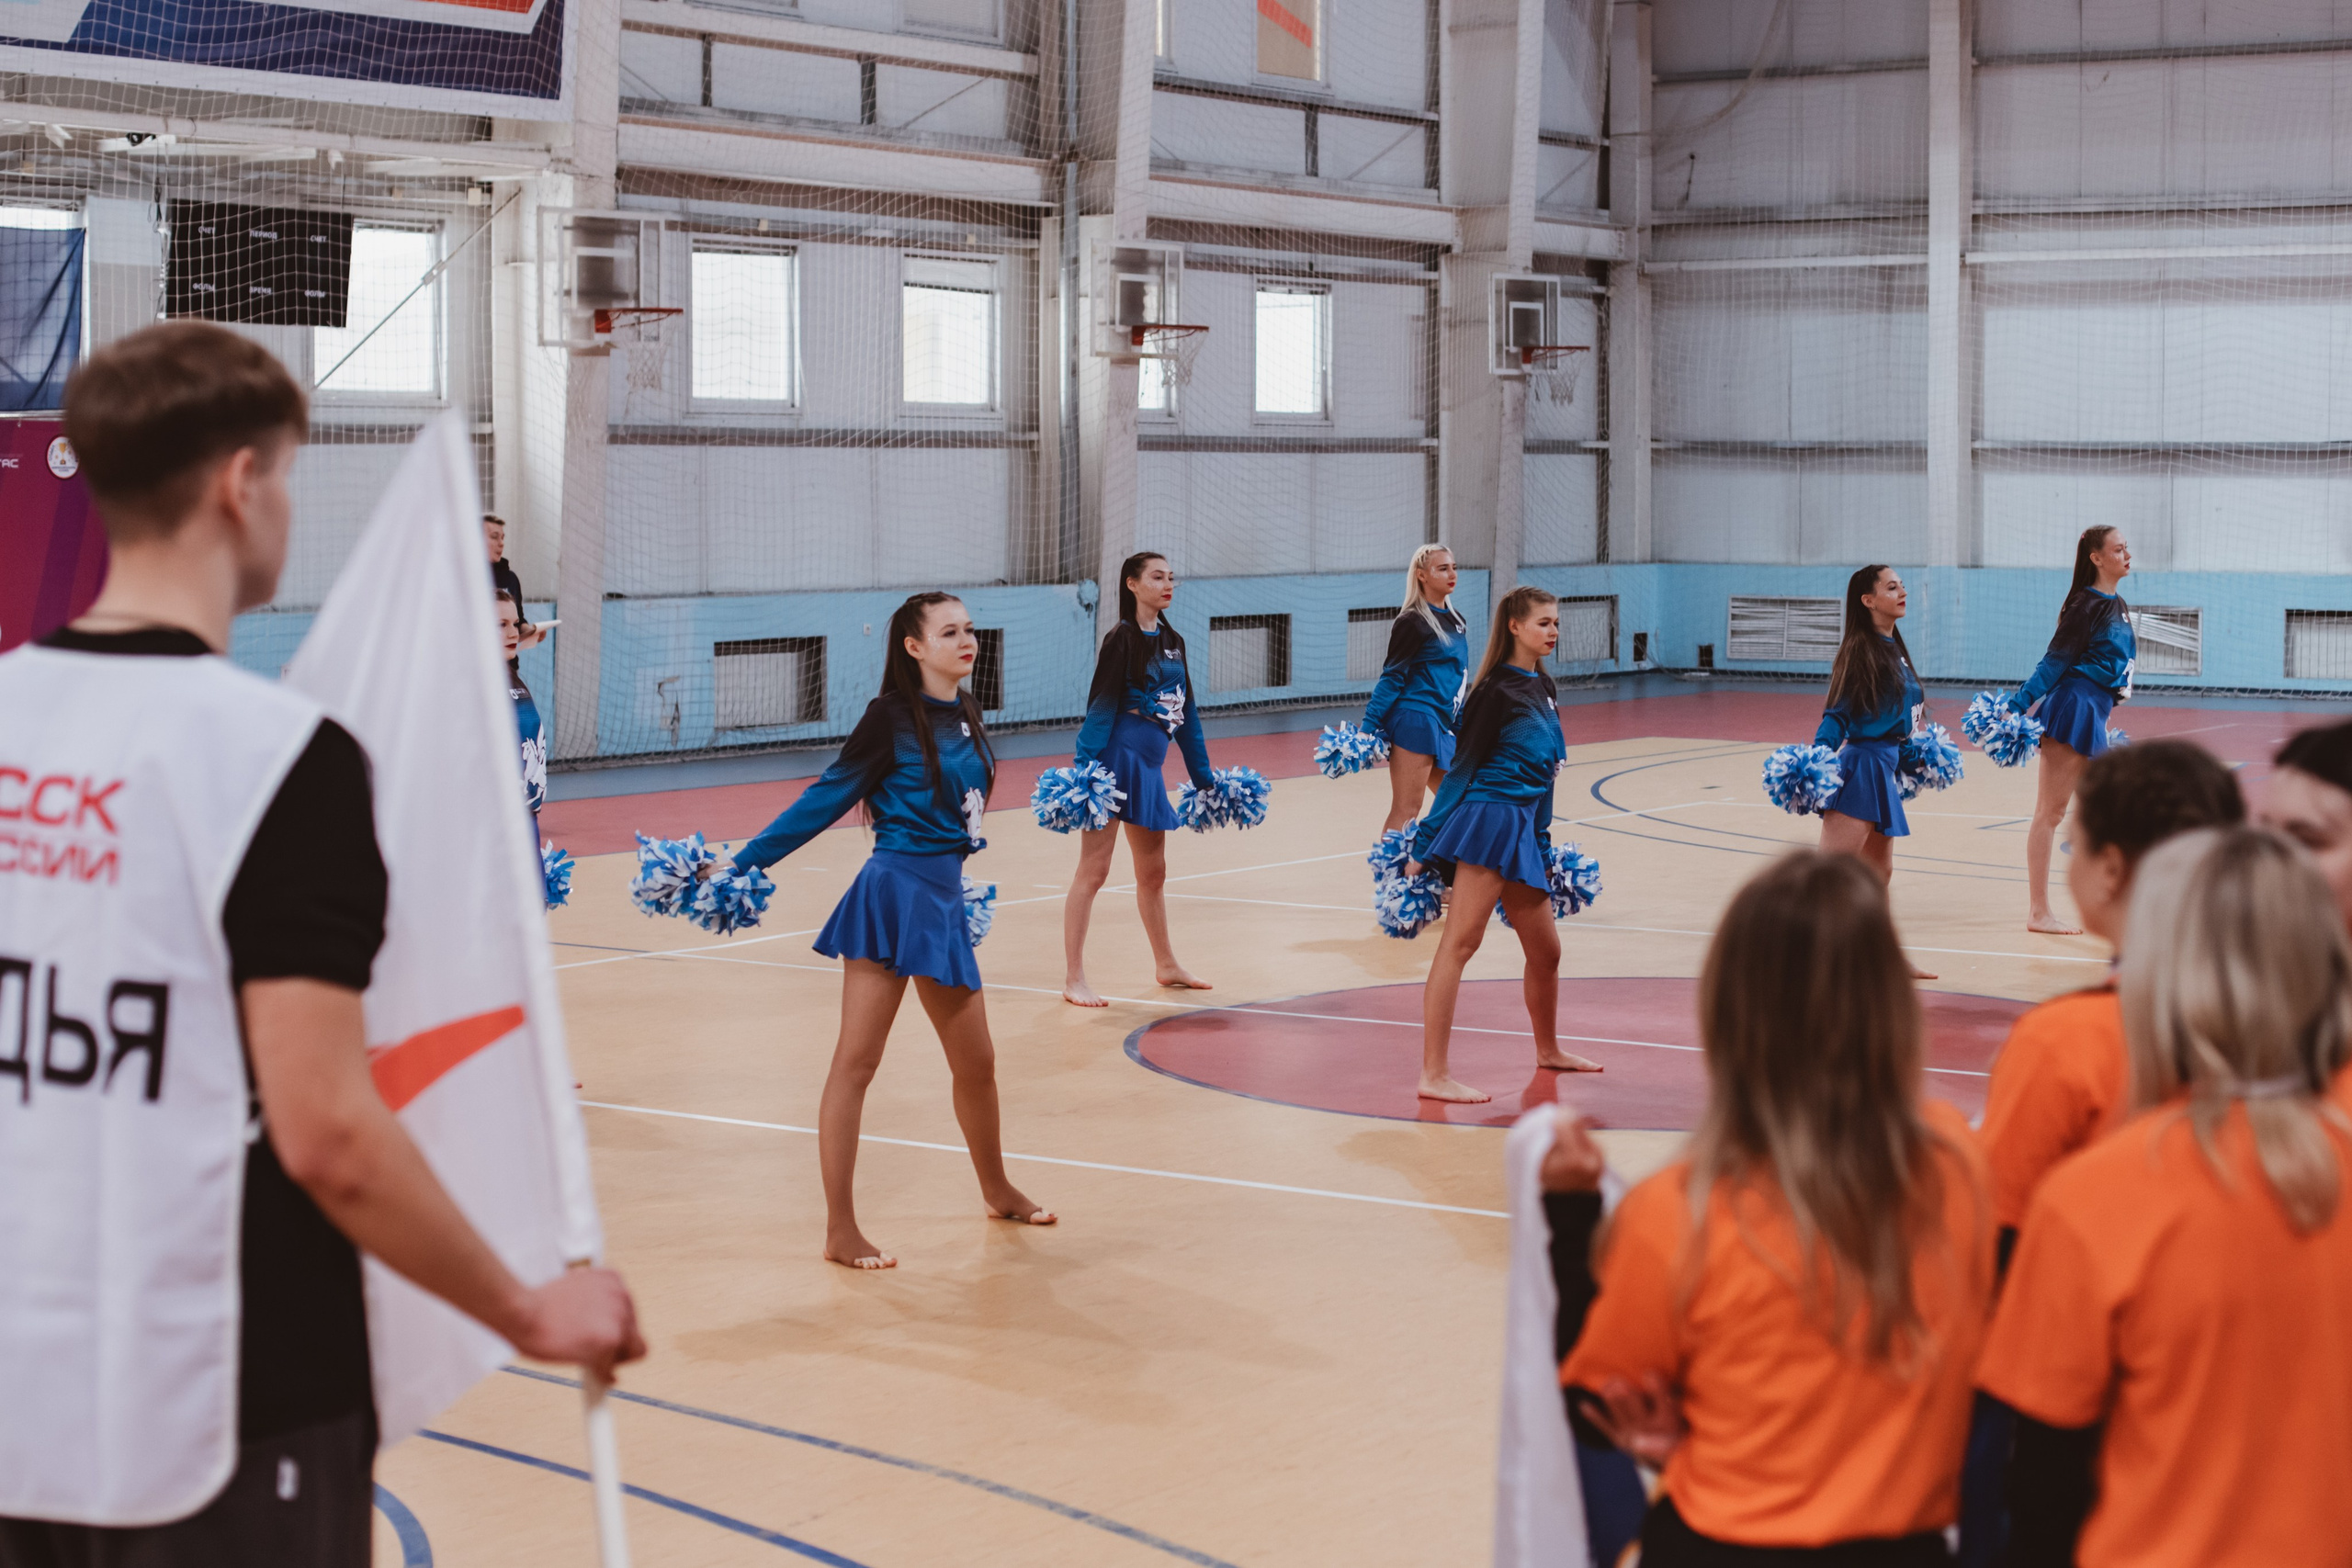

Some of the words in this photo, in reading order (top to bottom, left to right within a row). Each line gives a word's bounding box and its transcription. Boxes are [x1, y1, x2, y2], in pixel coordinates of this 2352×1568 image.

[198, 226, 216, 234] СЧЕТ
[249, 229, 277, 240] ПЕРИОД
[310, 234, 327, 243] СЧЕТ
[192, 282, 215, 291] ФОЛЫ
[249, 286, 272, 295] ВРЕМЯ
[304, 289, 326, 299] ФОЛЫ
